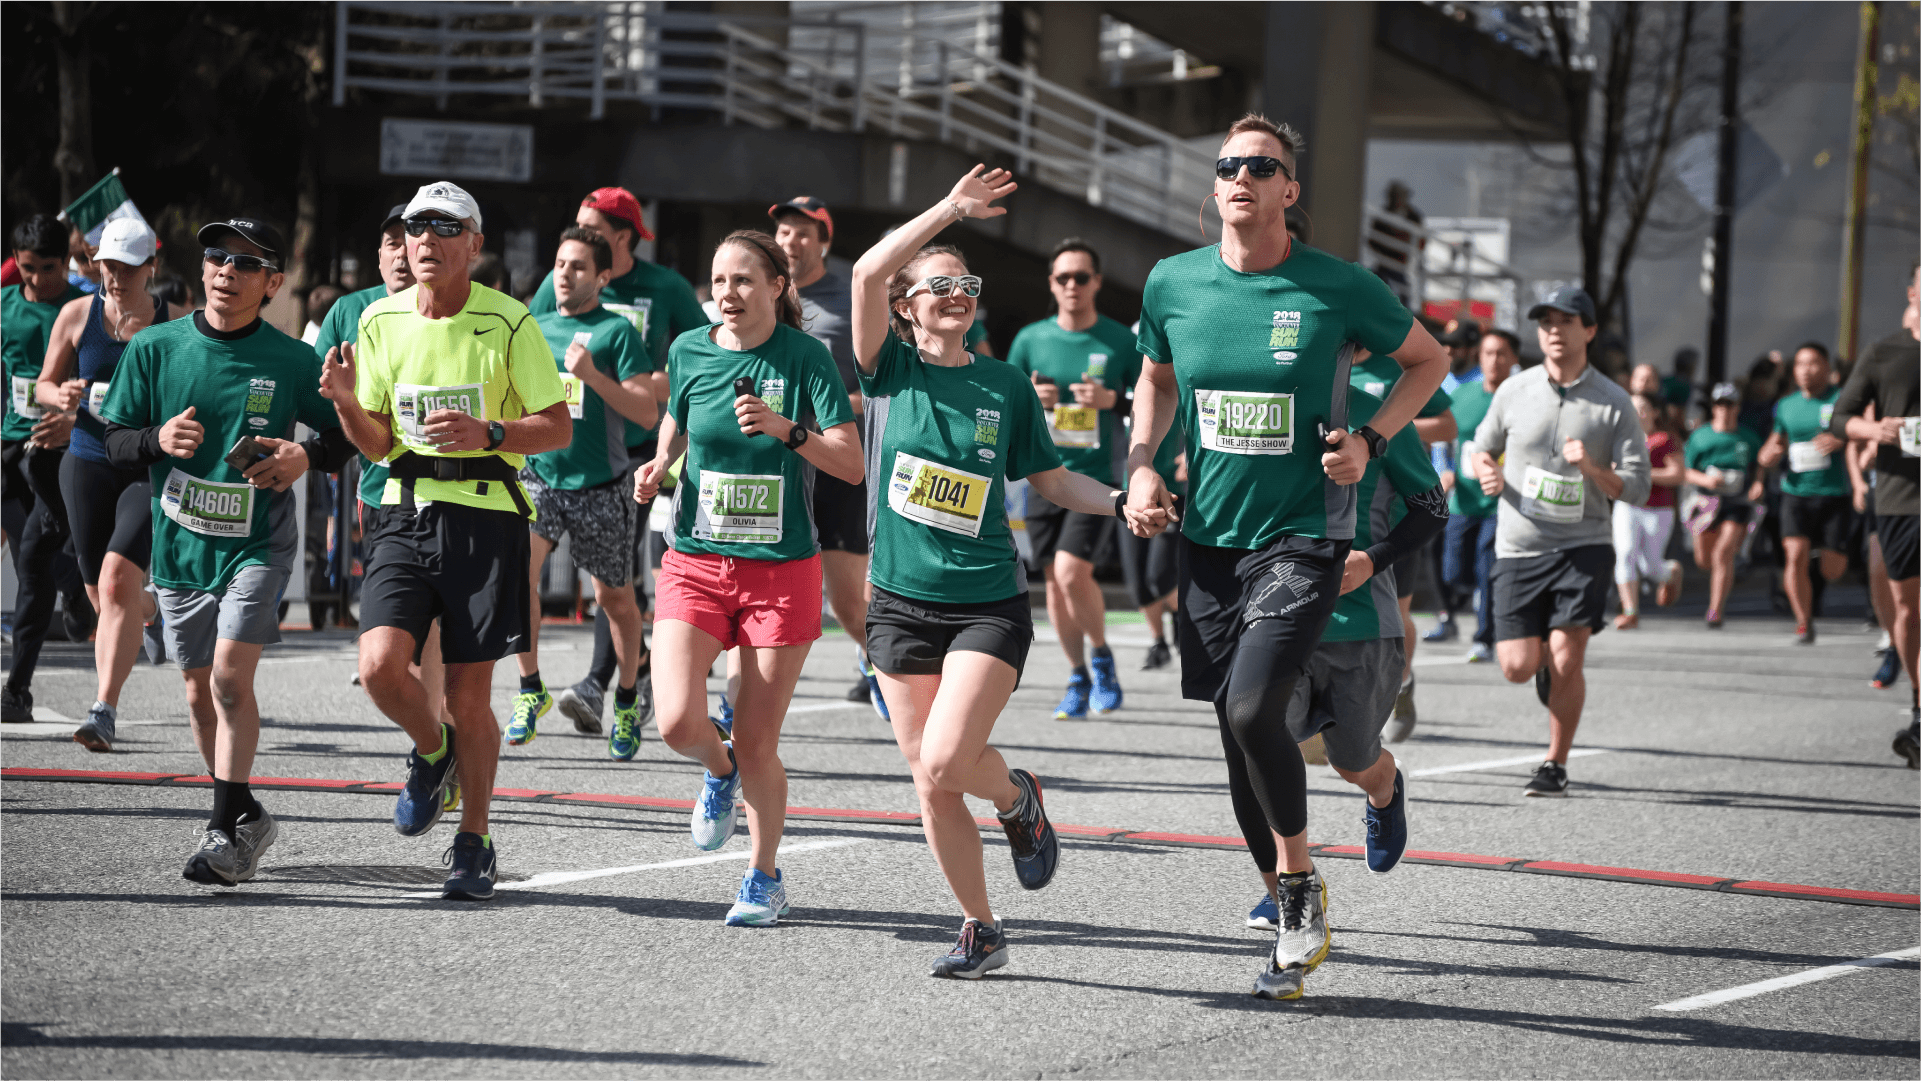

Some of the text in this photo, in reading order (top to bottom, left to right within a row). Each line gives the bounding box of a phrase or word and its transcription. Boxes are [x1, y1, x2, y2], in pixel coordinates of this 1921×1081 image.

[1273, 311, 1301, 320] 2018
[1271, 328, 1300, 338] SUN
[1269, 337, 1298, 347] RUN
[250, 379, 276, 388] 2018
[761, 379, 784, 387] 2018
[248, 395, 273, 405] SUN
[246, 402, 271, 413] RUN
[1202, 407, 1216, 415] RUN
[976, 408, 1001, 420] 2018
[1224, 402, 1282, 430] 19220
[976, 425, 998, 436] SUN
[974, 433, 998, 446] RUN
[1221, 438, 1287, 448] THE JESSE SHOW
[897, 465, 915, 475] SUN
[896, 471, 913, 482] RUN
[167, 486, 181, 494] RUN
[928, 475, 971, 509] 1041
[188, 487, 242, 516] 14606
[722, 484, 769, 509] 11572
[190, 518, 234, 531] GAME OVER
[732, 517, 757, 526] OLIVIA
[1280, 591, 1319, 616] ARMOUR
